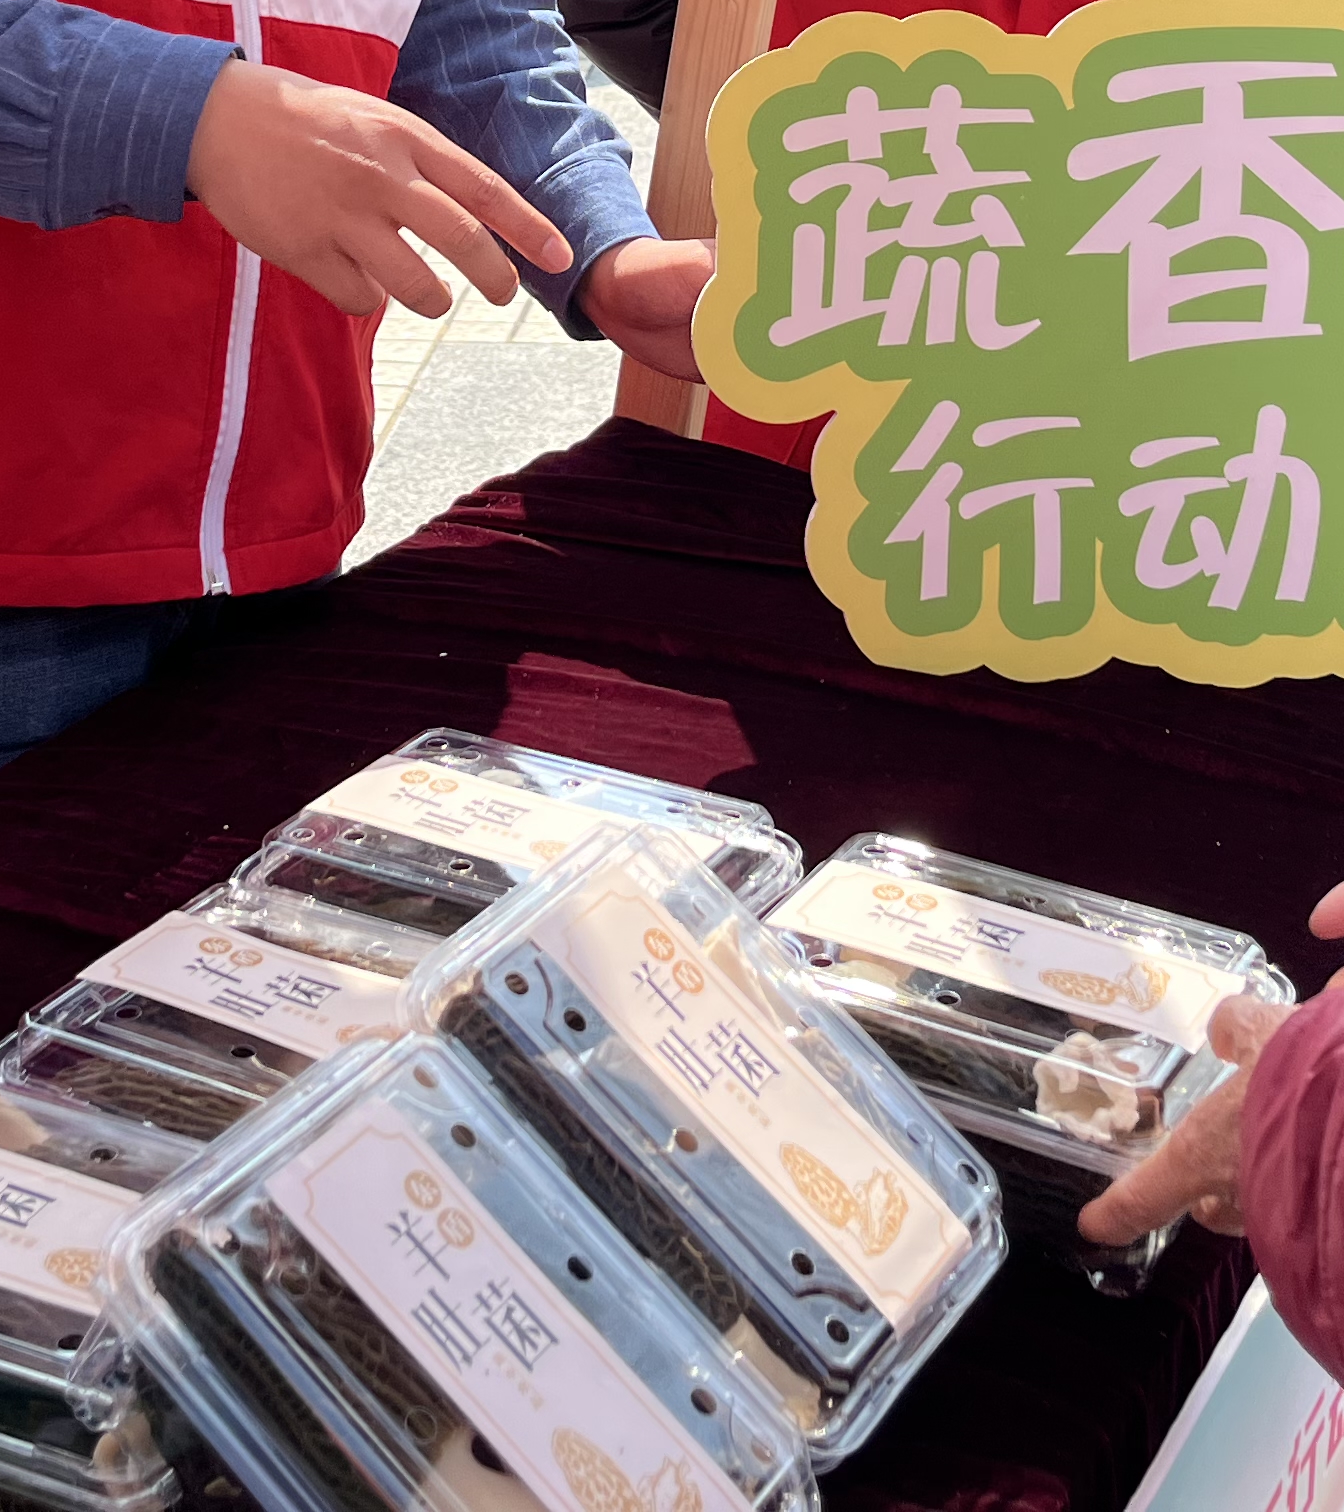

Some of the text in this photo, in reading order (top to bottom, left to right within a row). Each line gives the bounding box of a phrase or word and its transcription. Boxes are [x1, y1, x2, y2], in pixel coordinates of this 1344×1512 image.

[183, 955, 342, 1020] 羊肚菌
[631, 960, 780, 1098] 羊肚菌
[385, 1208, 560, 1375] 羊肚菌
